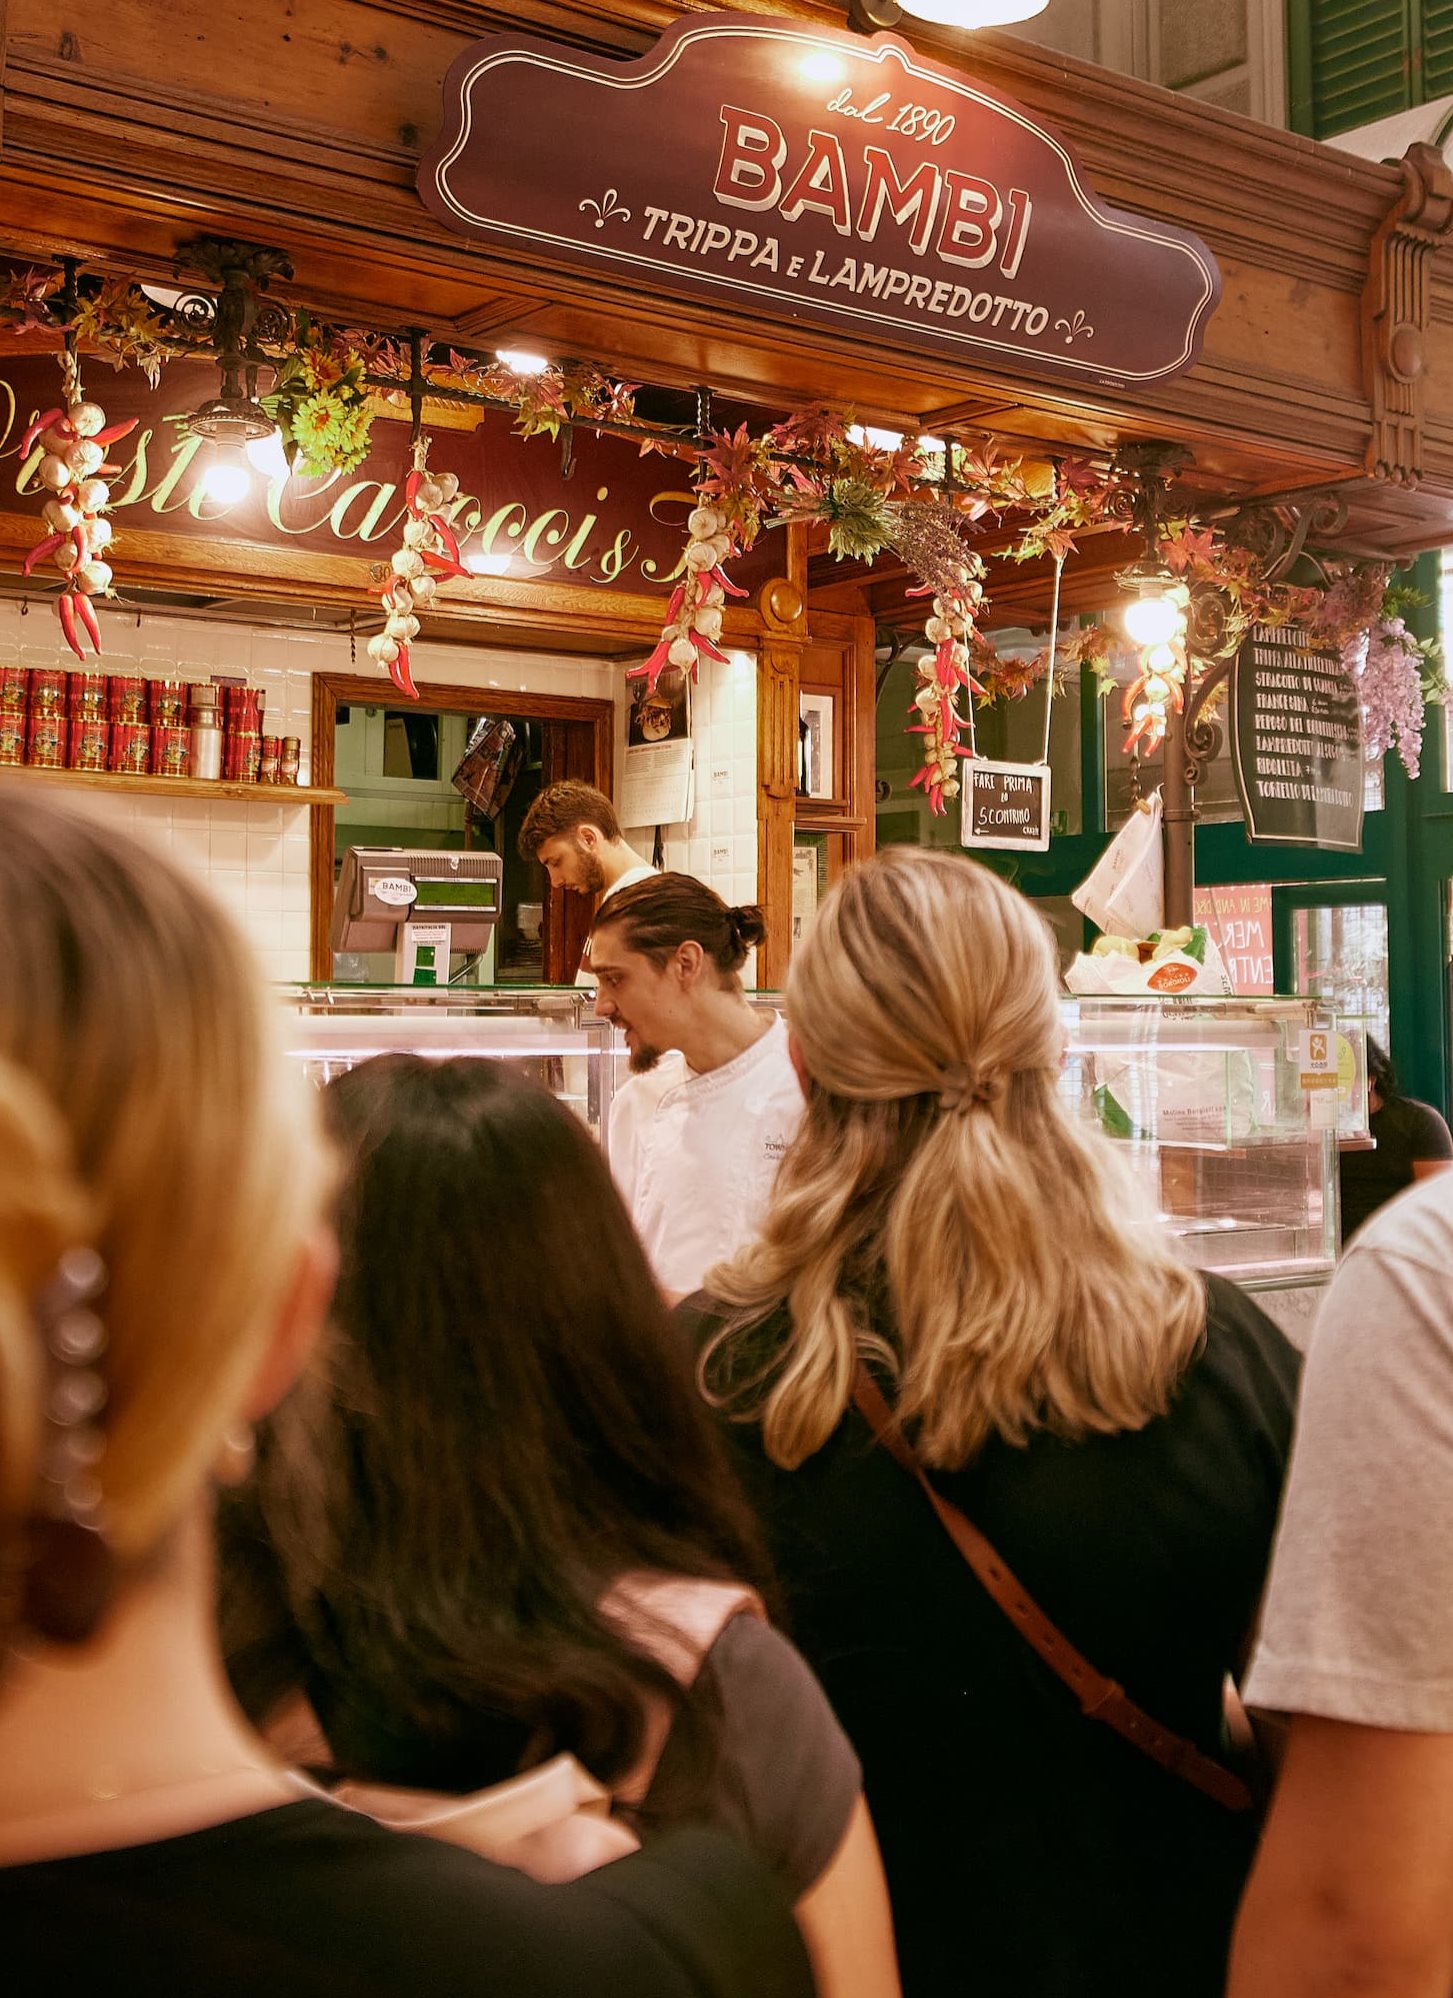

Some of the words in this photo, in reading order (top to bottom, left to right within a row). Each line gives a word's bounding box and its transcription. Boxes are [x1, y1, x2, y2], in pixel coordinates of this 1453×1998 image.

[827, 88, 891, 124] dal
[885, 101, 956, 146] 1890
[712, 103, 1032, 280] BAMBI
[642, 206, 781, 273] TRIPPA
[785, 255, 806, 279] E
[807, 250, 1050, 337] LAMPREDOTTO
[974, 772, 995, 790] FARE
[1004, 775, 1033, 794] PRIMA
[978, 806, 1031, 826] SCONTRINO
[382, 881, 412, 894] BAMBI
